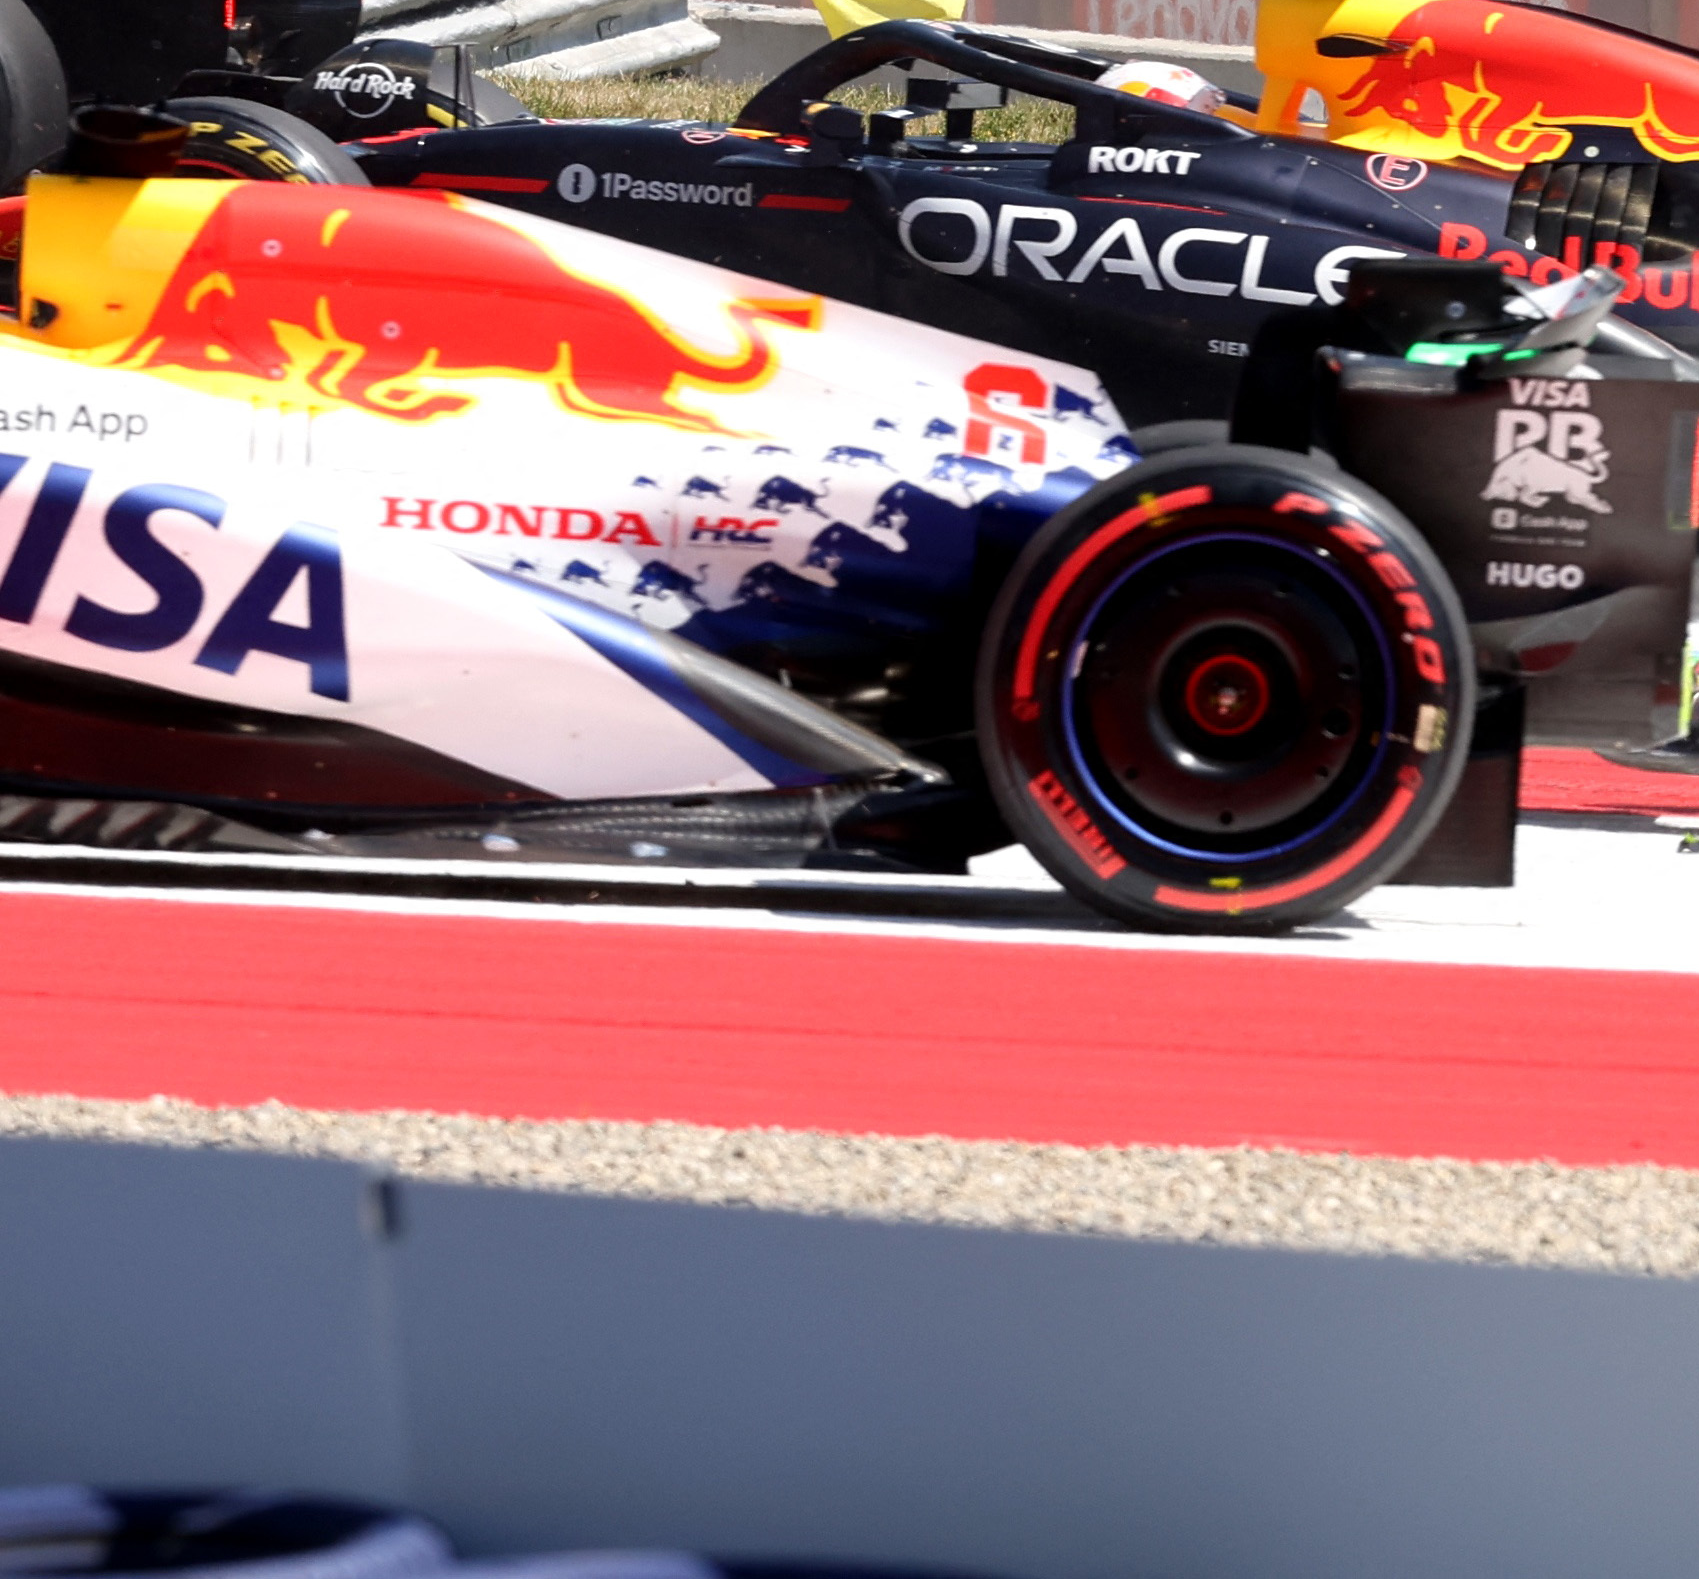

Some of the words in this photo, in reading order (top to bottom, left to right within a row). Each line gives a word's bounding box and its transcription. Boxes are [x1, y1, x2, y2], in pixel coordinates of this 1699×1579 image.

[314, 71, 364, 92] Hard
[366, 72, 416, 100] Rock
[1088, 146, 1201, 175] ROKT
[601, 171, 754, 207] 1Password
[901, 197, 1407, 307] ORACLE
[1509, 377, 1591, 407] VISA
[68, 404, 148, 442] App
[1272, 491, 1330, 514] P
[379, 496, 663, 548] HONDA
[0, 453, 350, 703] ISA
[1486, 561, 1585, 590] HUGO
